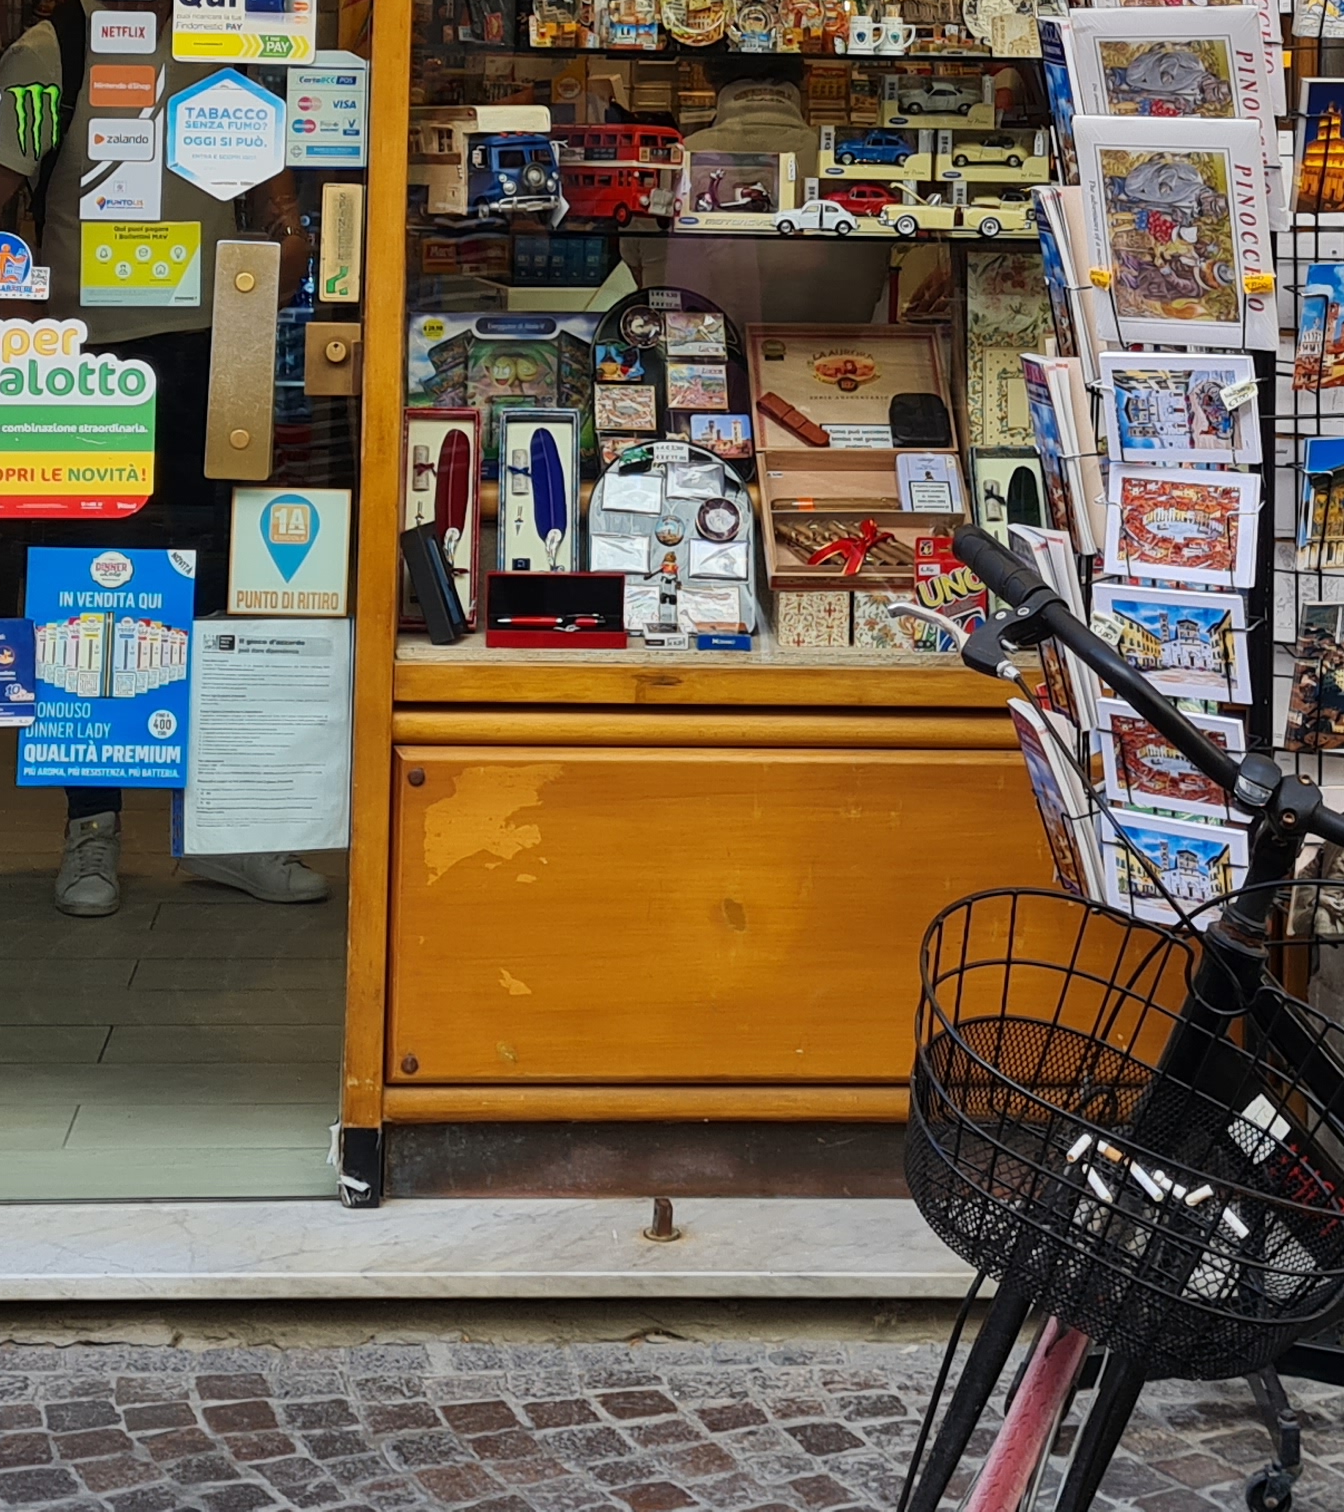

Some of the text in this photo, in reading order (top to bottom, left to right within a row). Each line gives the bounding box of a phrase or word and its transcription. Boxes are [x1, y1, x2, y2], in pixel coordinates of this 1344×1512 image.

[101, 25, 146, 39] NETFLIX
[266, 41, 290, 53] PAY
[333, 100, 357, 109] VISA
[185, 106, 269, 120] TABACCO
[185, 120, 268, 131] SENZA FUMO?
[106, 133, 150, 144] zalando
[183, 136, 217, 147] OGGI
[220, 136, 233, 147] SI
[41, 468, 63, 482] LE
[59, 591, 163, 610] IN VENDITA QUI
[236, 590, 339, 610] PUNTO DI RITIRO
[25, 721, 112, 739] DINNER LADY
[23, 740, 182, 764] QUALITÀ PREMIUM
